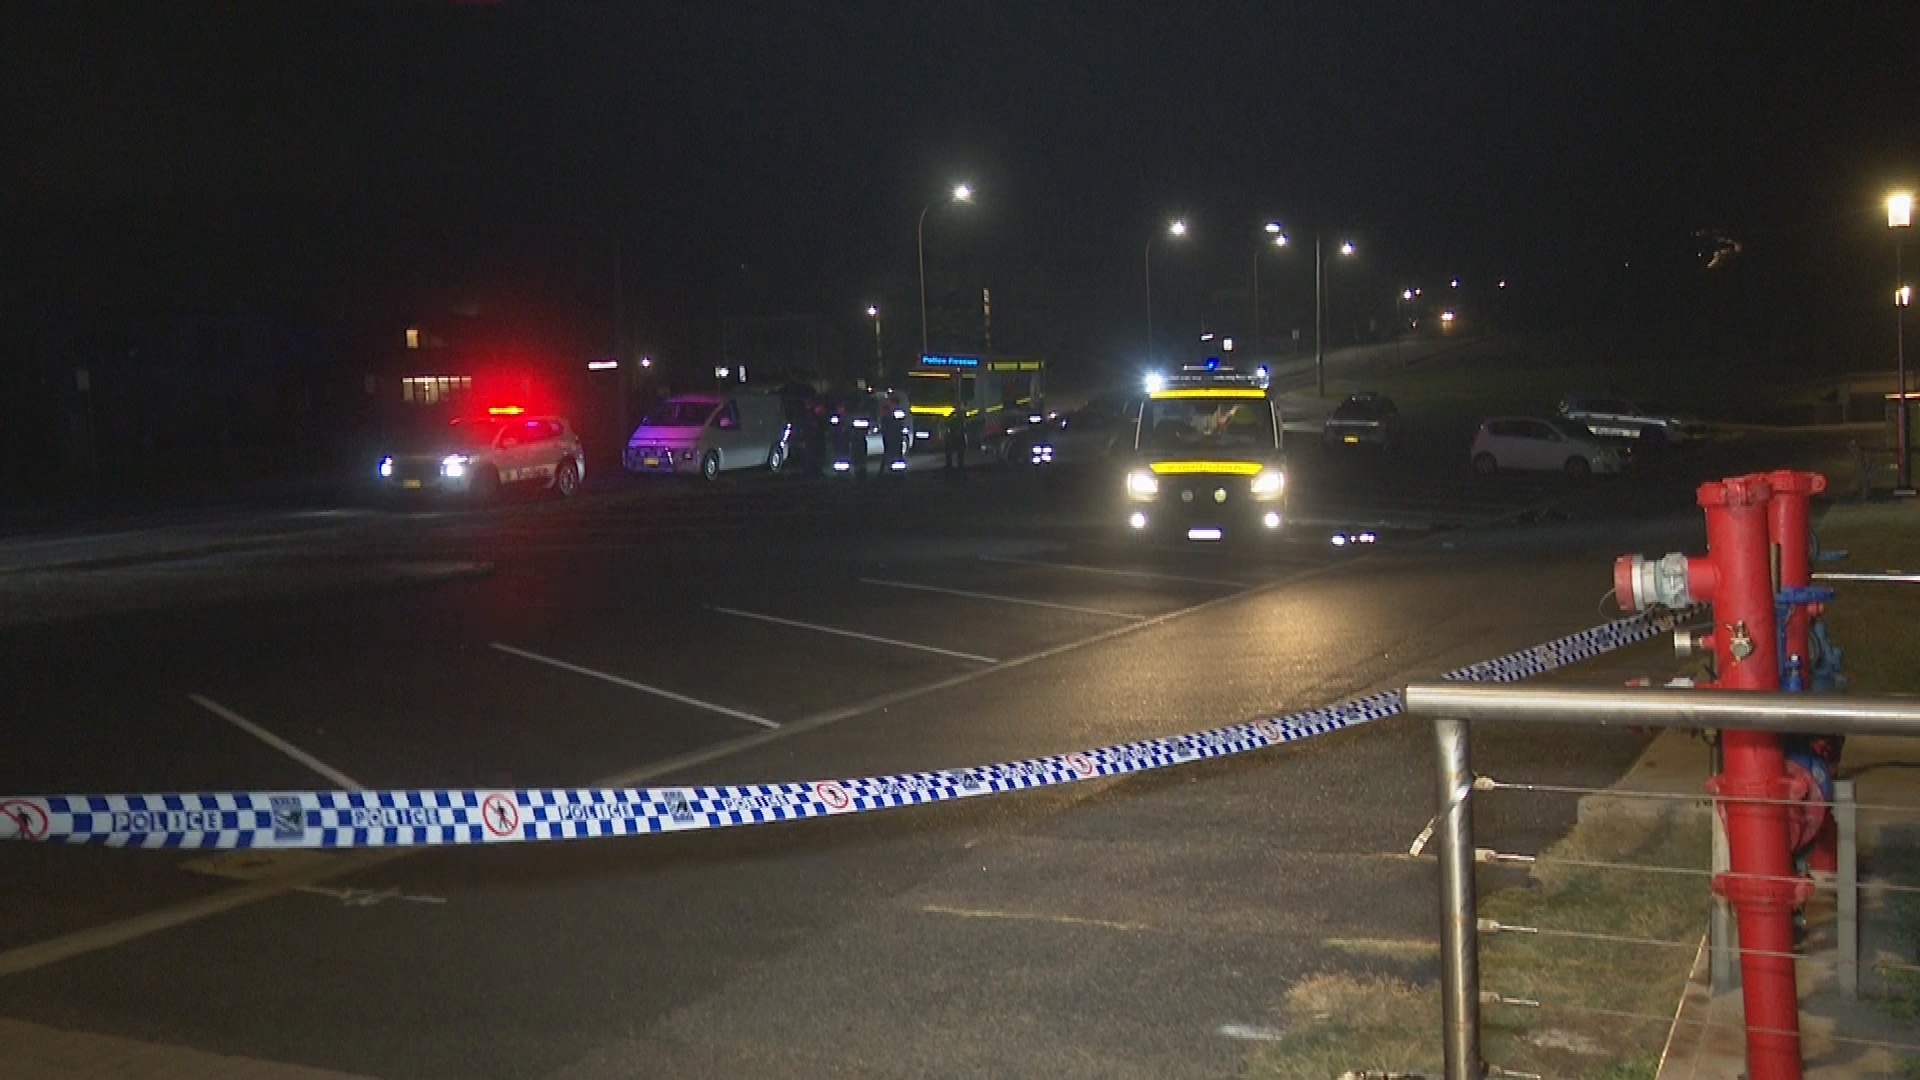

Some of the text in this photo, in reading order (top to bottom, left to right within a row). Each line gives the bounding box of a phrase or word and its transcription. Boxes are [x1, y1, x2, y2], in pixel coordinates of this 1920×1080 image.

[111, 810, 219, 832] POLICE
[352, 807, 440, 827] POLICE
[559, 803, 632, 820] POLICE
